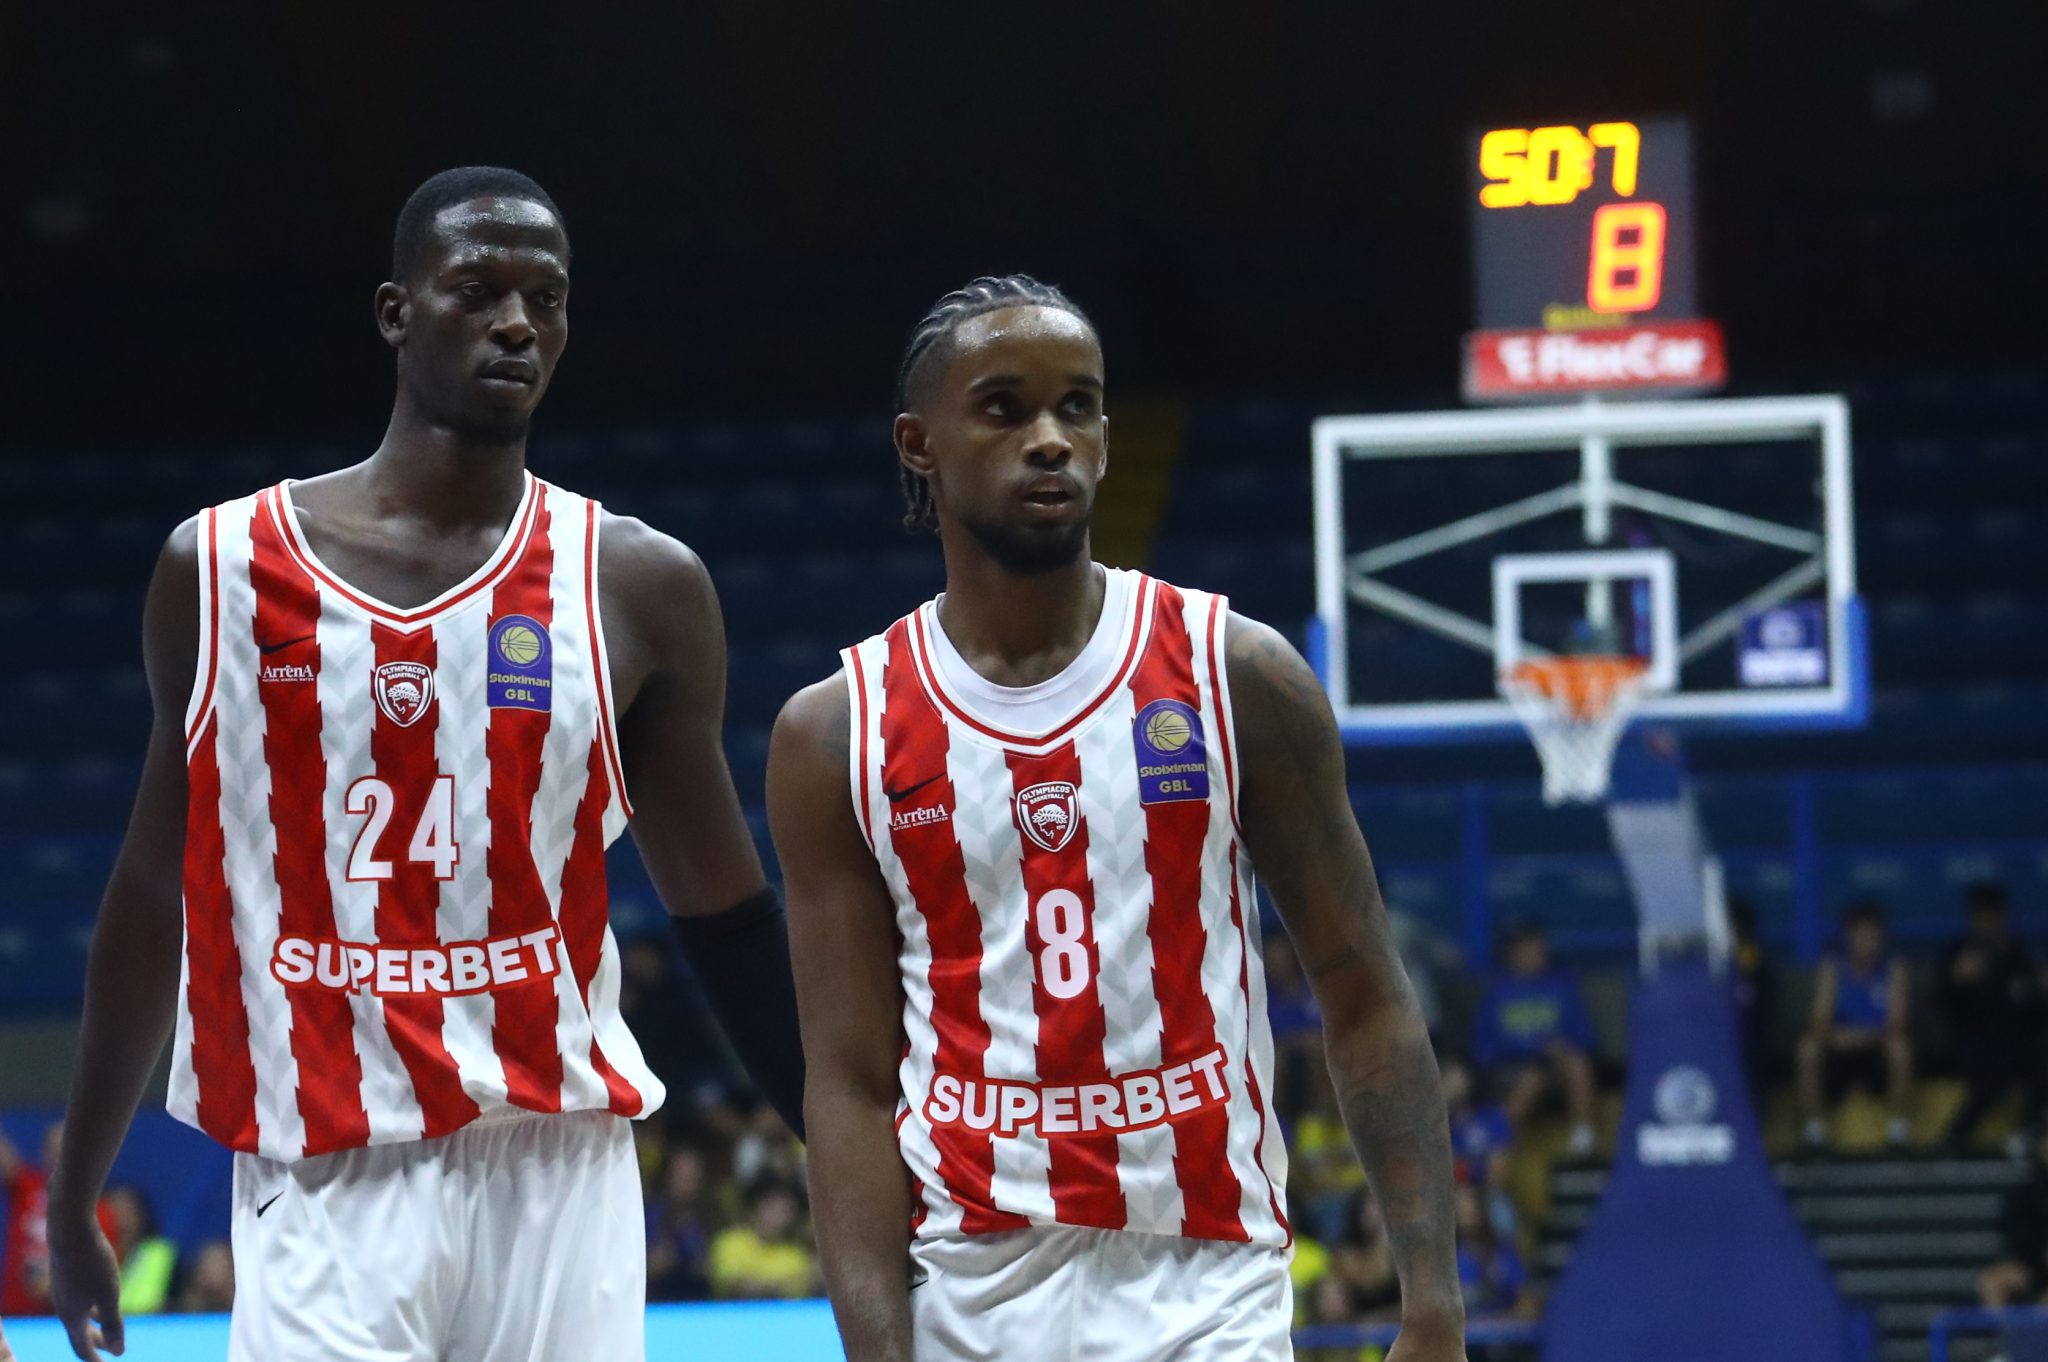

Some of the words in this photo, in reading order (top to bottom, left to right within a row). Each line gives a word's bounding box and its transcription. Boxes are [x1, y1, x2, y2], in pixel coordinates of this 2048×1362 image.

[1587, 202, 1667, 314] 8
[381, 665, 426, 676] OLYMPIACOS
[504, 688, 536, 702] GBL
[1021, 786, 1071, 801] OLYMPIACOS
[1029, 793, 1066, 805] BASKETBALL
[1159, 780, 1193, 793] GBL
[345, 775, 460, 882] 24
[274, 926, 557, 993] SUPERBET
[1036, 888, 1090, 999] 8
[928, 1050, 1226, 1132] SUPERBET
